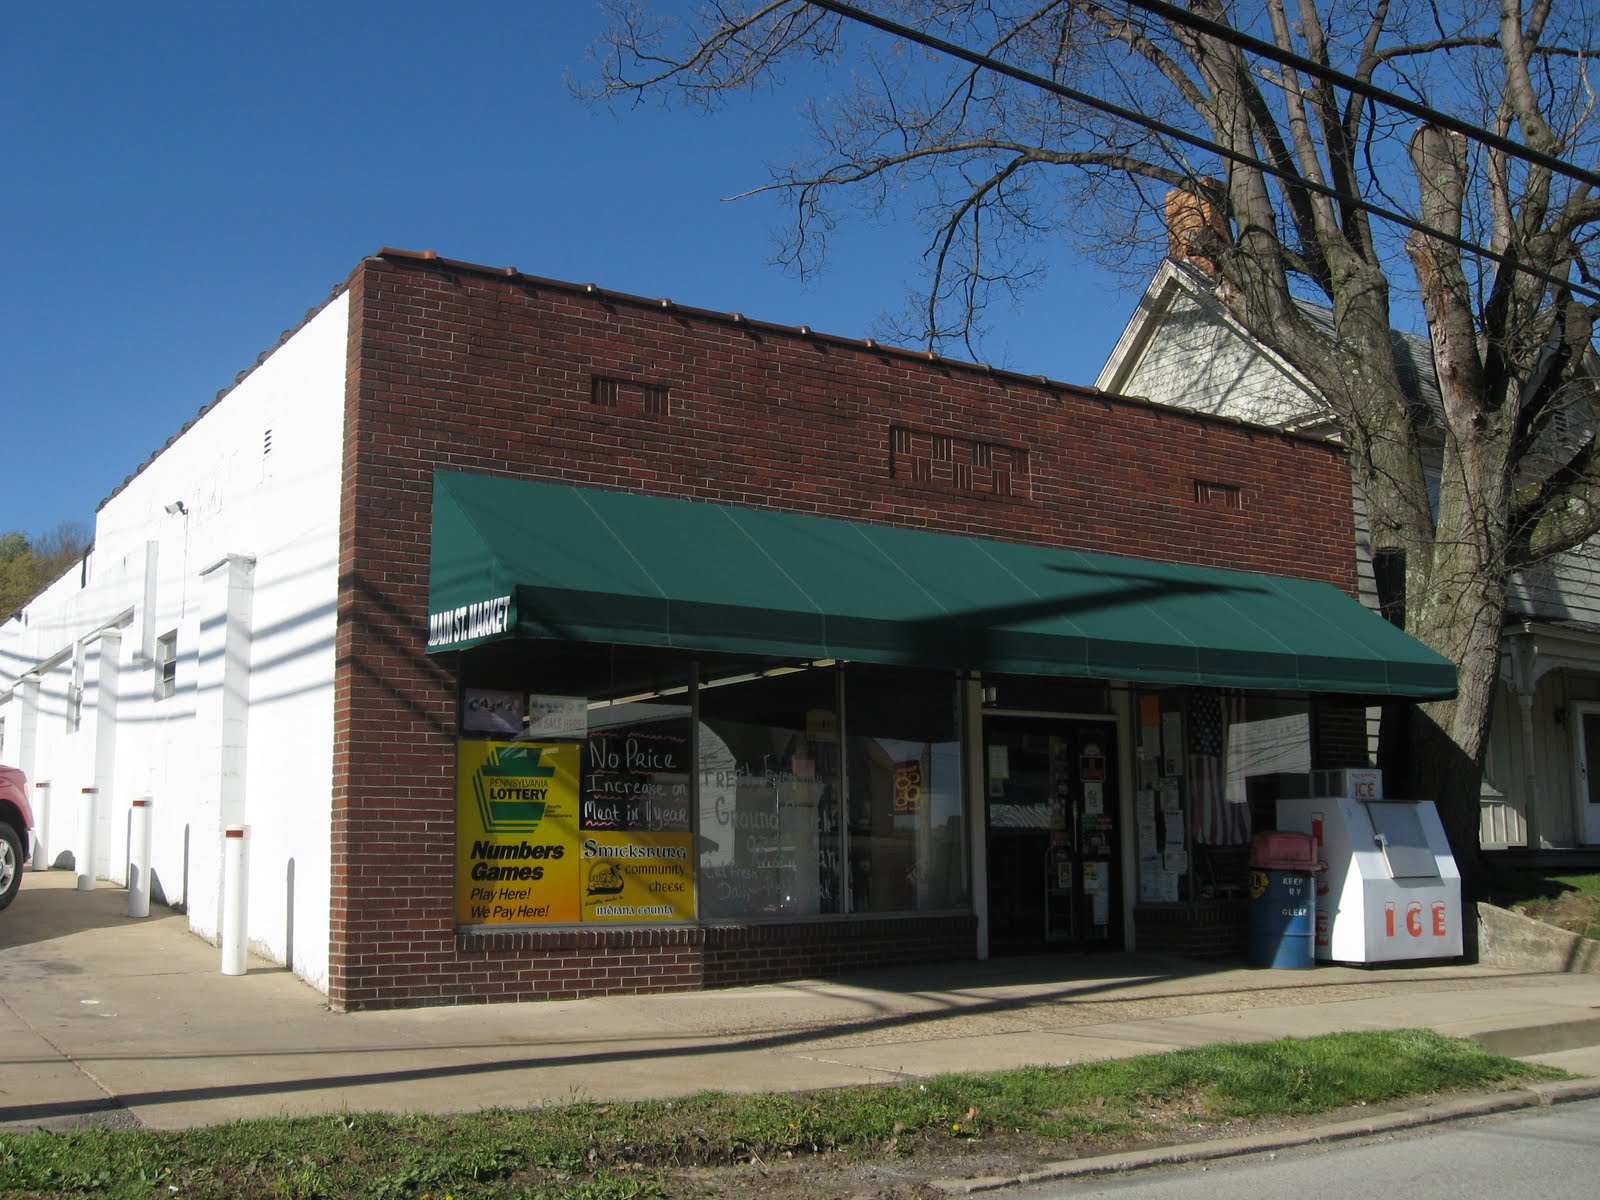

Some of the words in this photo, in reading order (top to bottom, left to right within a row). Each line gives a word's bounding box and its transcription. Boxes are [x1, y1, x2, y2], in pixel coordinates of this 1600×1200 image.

[428, 609, 454, 646] MAIN
[454, 606, 468, 643] ST.
[468, 596, 511, 639] MARKET
[590, 738, 619, 768] No
[489, 779, 548, 788] PENNSYLVANIA
[586, 774, 667, 796] Increase
[672, 783, 688, 796] on
[1355, 782, 1375, 797] ICE
[489, 788, 549, 800] LOTTERY
[584, 800, 621, 821] Meat
[470, 841, 565, 860] Numbers
[471, 862, 545, 881] Games
[1283, 877, 1304, 886] KEEP
[470, 888, 498, 903] Play
[499, 888, 532, 900] Here!
[471, 906, 491, 919] We
[492, 905, 517, 920] Pay
[517, 905, 550, 918] Here!
[1385, 900, 1446, 937] ICE
